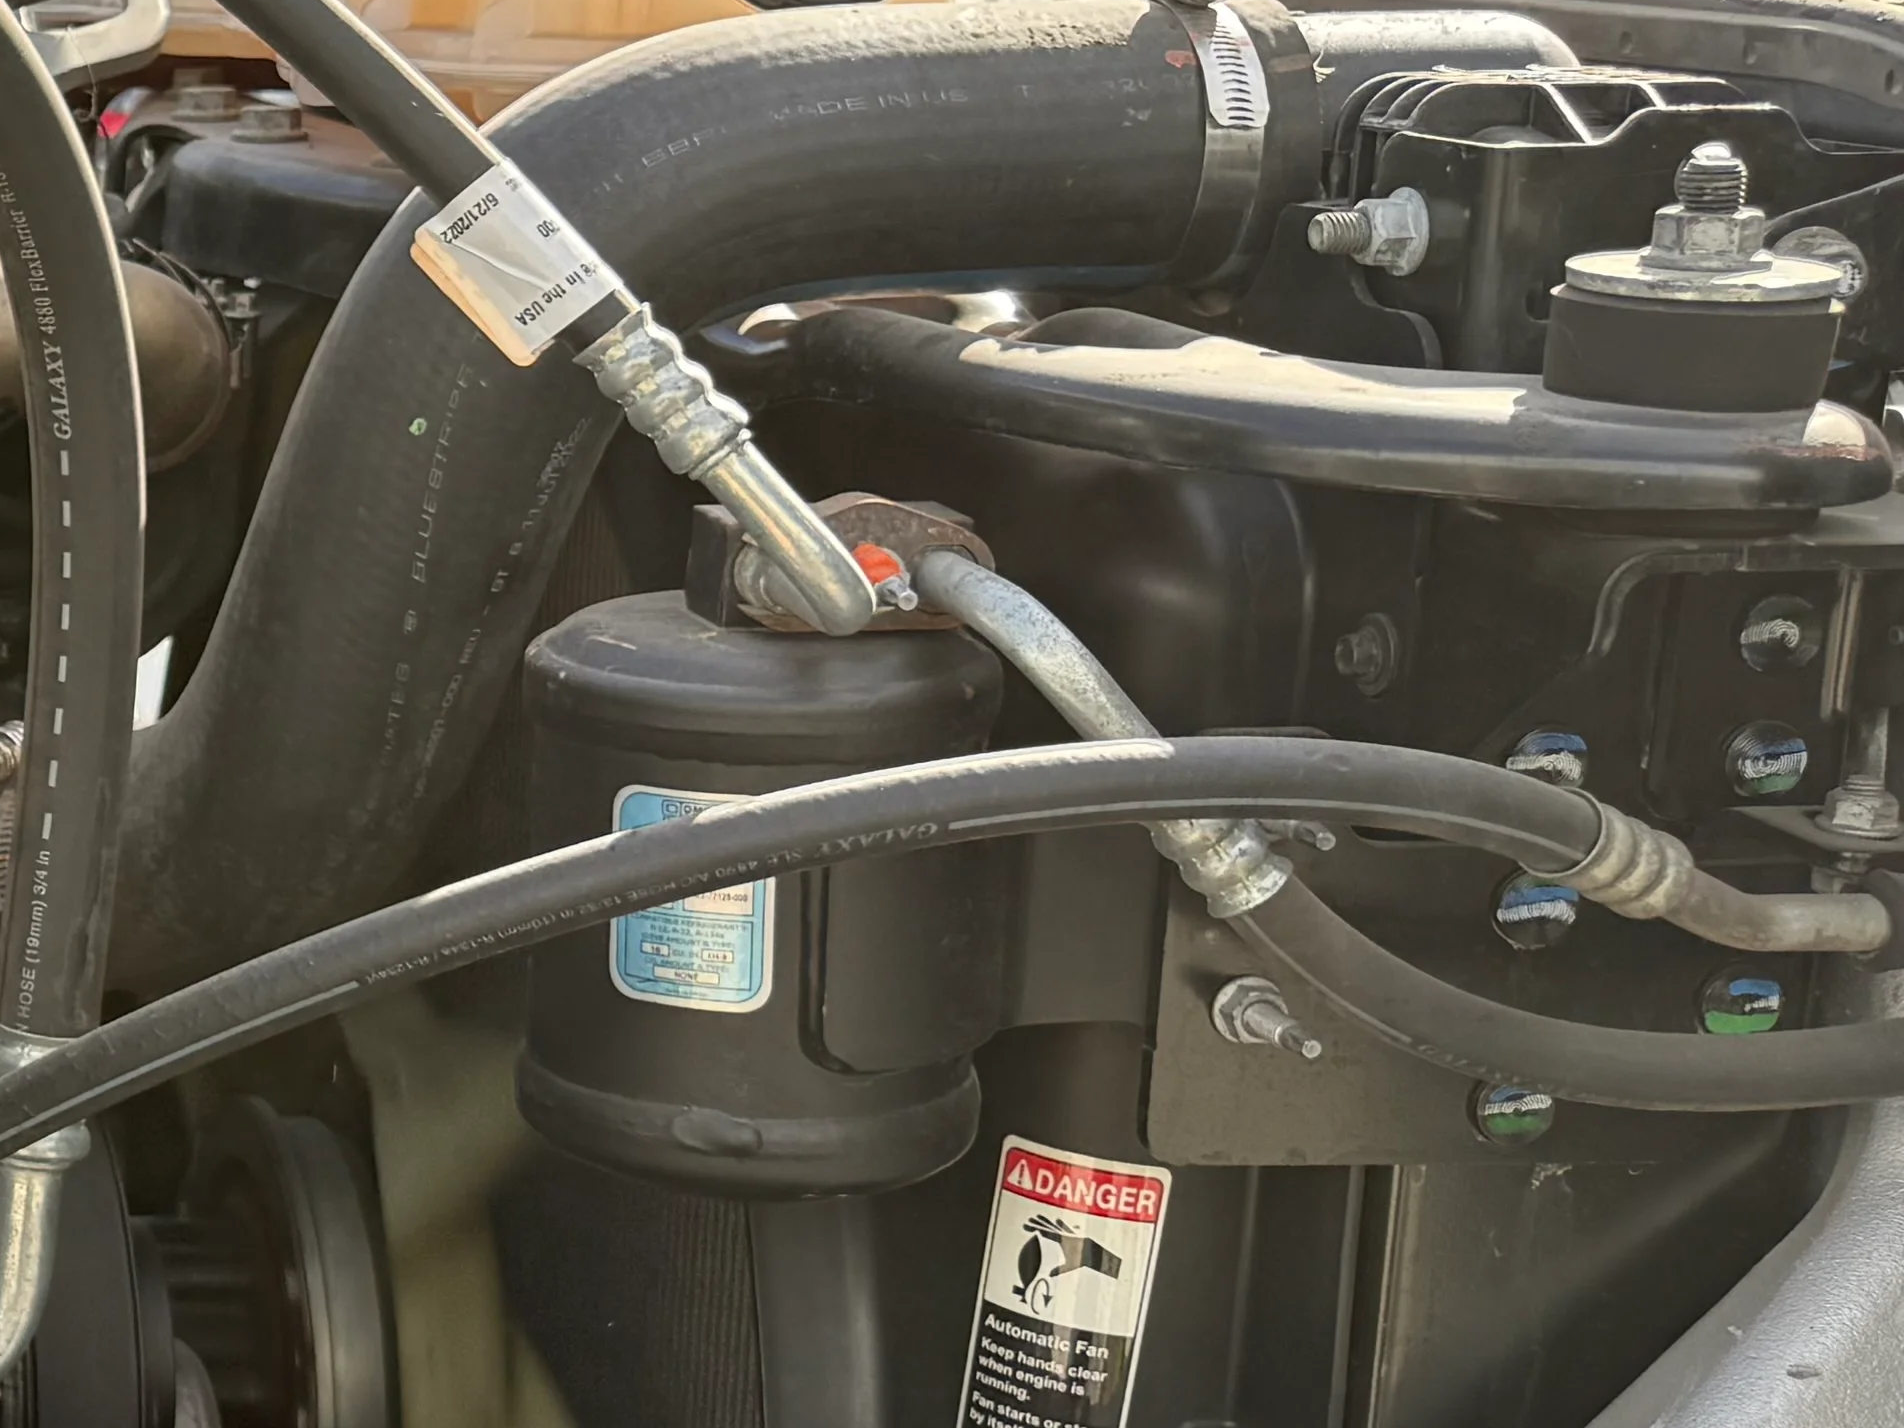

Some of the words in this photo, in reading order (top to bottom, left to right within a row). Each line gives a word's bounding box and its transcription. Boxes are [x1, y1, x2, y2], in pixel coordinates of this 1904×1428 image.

[541, 283, 567, 304] the
[35, 296, 57, 335] 4880
[514, 301, 546, 326] USA
[43, 341, 72, 440] GALAXY
[814, 821, 938, 858] GALAXY
[33, 870, 49, 896] 3/4
[25, 900, 48, 964] (19mm)
[17, 968, 36, 1019] HOSE
[1034, 1167, 1157, 1216] DANGER
[984, 1313, 1070, 1351] Automatic
[1075, 1341, 1110, 1360] Fan
[978, 1355, 1014, 1378] when
[1016, 1367, 1067, 1395] engine
[1071, 1381, 1085, 1396] is
[981, 1337, 1015, 1361] Keep
[1017, 1350, 1064, 1374] hands
[1068, 1365, 1108, 1383] clear
[975, 1371, 1031, 1403] running.
[969, 1407, 985, 1427] by
[972, 1392, 995, 1413] Fan
[997, 1399, 1040, 1427] starts
